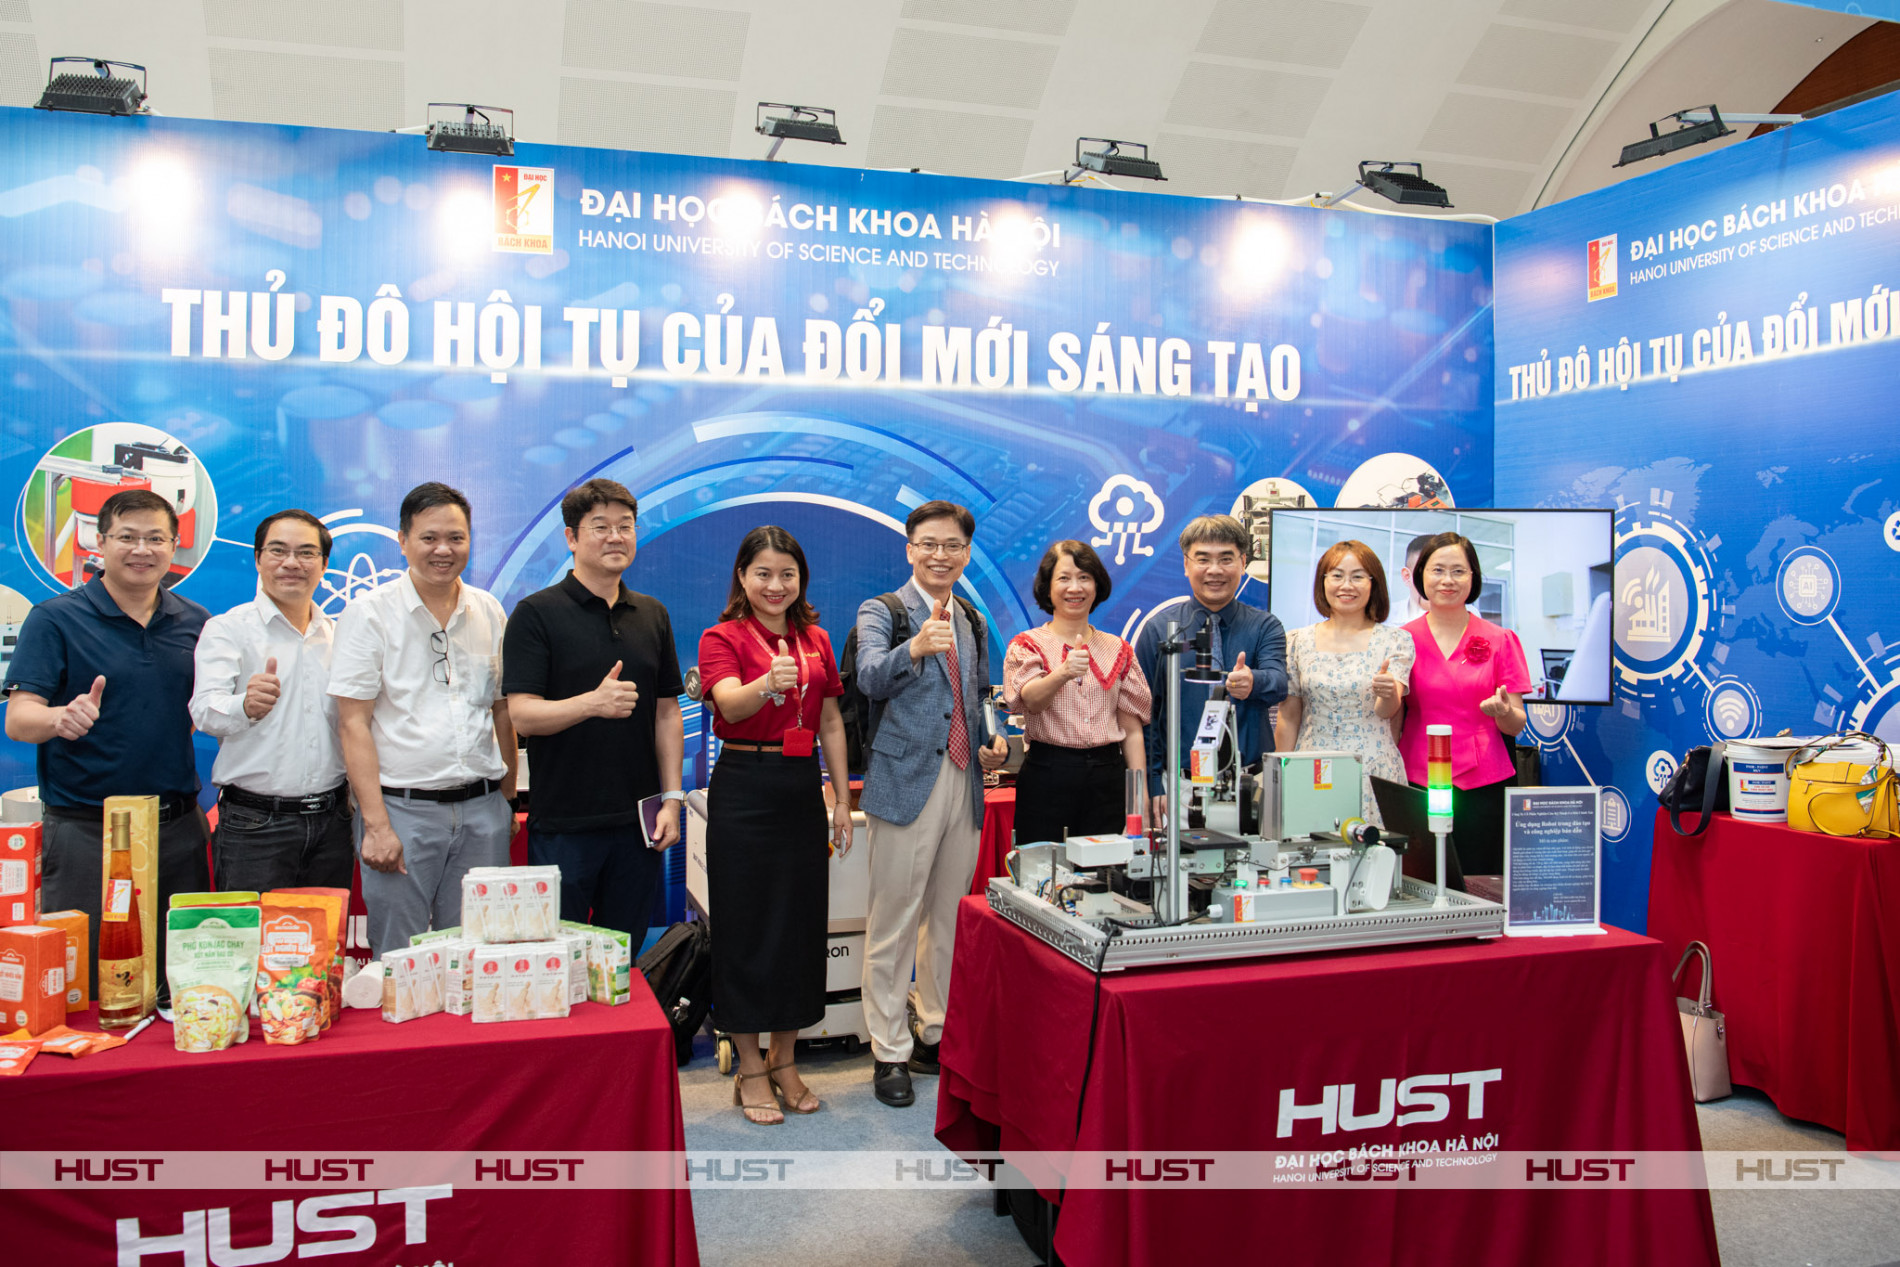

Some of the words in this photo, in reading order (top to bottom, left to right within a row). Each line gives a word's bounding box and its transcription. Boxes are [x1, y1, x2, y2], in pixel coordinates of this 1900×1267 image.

[579, 229, 647, 251] HANOI
[653, 233, 761, 259] UNIVERSITY
[766, 241, 794, 260] OF
[799, 243, 882, 265] SCIENCE
[886, 249, 929, 268] AND
[580, 188, 641, 223] ĐẠI
[752, 195, 838, 232] ÁCH
[849, 207, 942, 239] KHOA
[952, 210, 994, 242] HÀ
[1629, 233, 1664, 262] ĐẠI
[1669, 219, 1718, 251] HỌC
[1723, 198, 1787, 237] BÁCH
[1793, 178, 1866, 219] KHOA
[1629, 263, 1667, 286] HANOI
[1669, 246, 1736, 276] UNIVERSITY
[1737, 240, 1757, 259] OF
[1759, 224, 1820, 253] SCIENCE
[1822, 216, 1856, 238] AND
[1858, 202, 1900, 229] TECH
[162, 269, 296, 363] THỦ
[317, 283, 410, 366] ĐÔ
[433, 289, 542, 385] HỘI
[563, 306, 641, 389] TỤ
[662, 292, 786, 382] CỦA
[802, 296, 901, 385] ĐỔI
[921, 315, 1029, 390] MỚI
[1046, 321, 1192, 397] SÁNG
[1207, 339, 1302, 413] TẠO
[1508, 348, 1552, 401] THỦ
[1557, 344, 1591, 393] ĐÔ
[1598, 336, 1642, 391] HỘI
[1649, 332, 1684, 383] TỤ
[1692, 310, 1755, 369] CỦA
[1761, 291, 1819, 358] ĐỔI
[1830, 283, 1900, 345] MỚI
[1276, 1067, 1503, 1139] HUST
[1272, 1172, 1306, 1183] HANOI
[1308, 1165, 1355, 1182] UNIVERSITY
[1356, 1163, 1371, 1174] OF
[1372, 1159, 1411, 1173] SCIENCE
[1411, 1158, 1433, 1169] AND
[1435, 1152, 1498, 1168] TECHNOLOGY
[1274, 1154, 1305, 1170] ĐẠI
[1309, 1150, 1346, 1168] HỌC
[1348, 1142, 1394, 1161] BÁCH
[1398, 1139, 1441, 1158] KHOA
[1445, 1134, 1469, 1152] HÀ
[1472, 1132, 1499, 1151] NỘI
[115, 1183, 454, 1267] HUST
